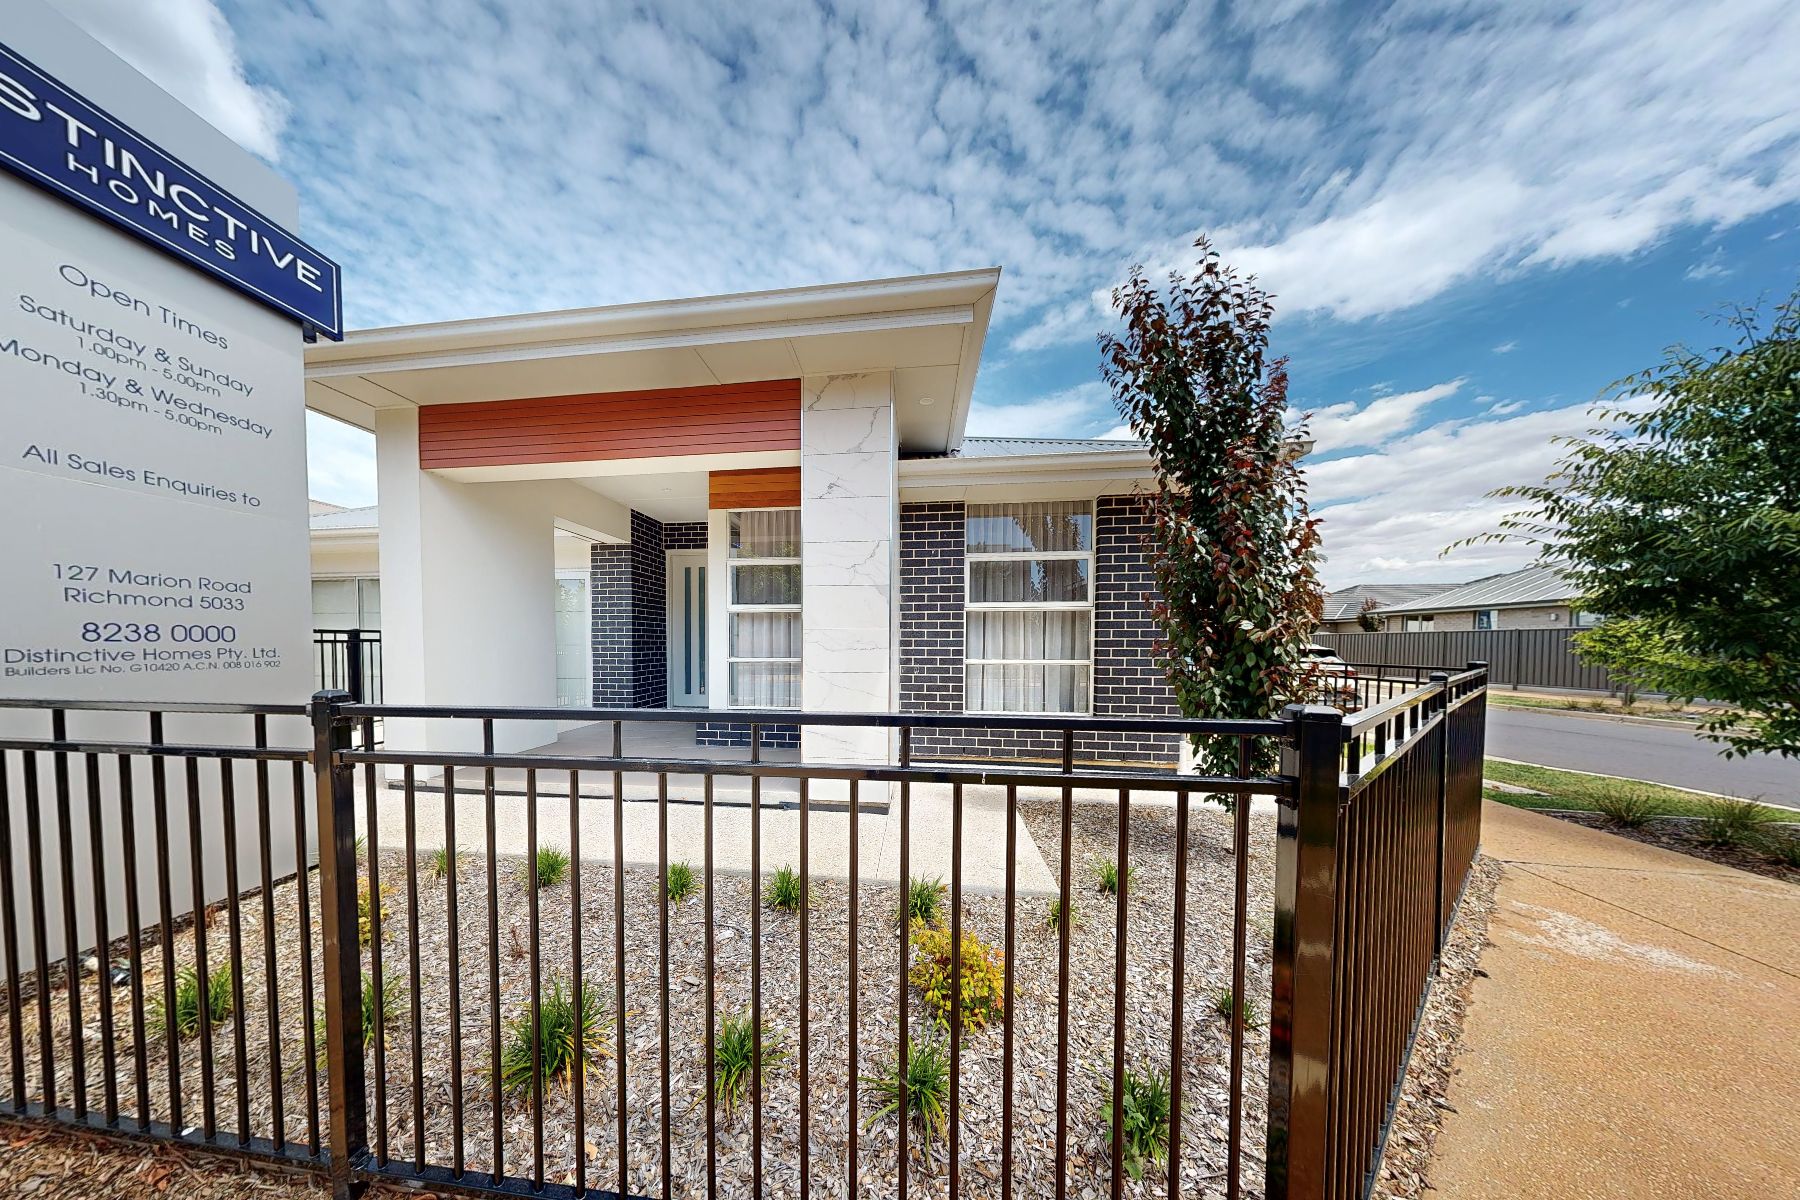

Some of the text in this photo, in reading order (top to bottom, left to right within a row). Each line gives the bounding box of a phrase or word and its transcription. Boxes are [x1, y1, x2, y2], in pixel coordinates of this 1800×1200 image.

[67, 152, 235, 261] HOMES
[59, 264, 229, 350] Open Times
[19, 295, 254, 397] Saturday & Sunday
[77, 336, 146, 372] 1.00pm
[162, 369, 221, 398] 5.00pm
[79, 381, 148, 414] 1.30pm
[164, 409, 222, 436] 5.00pm
[125, 378, 144, 396] &
[151, 386, 273, 439] Wednesday
[21, 444, 261, 508] All Sales Enquiries to
[53, 563, 252, 594] 127 Marion Road
[64, 587, 245, 611] Richmond 5033
[4, 647, 281, 664] Distinctive Homes Pty. Ltd.
[81, 621, 236, 643] 8238 0000
[4, 666, 71, 677] Builders
[100, 664, 125, 674] No.
[130, 662, 180, 672] G10420
